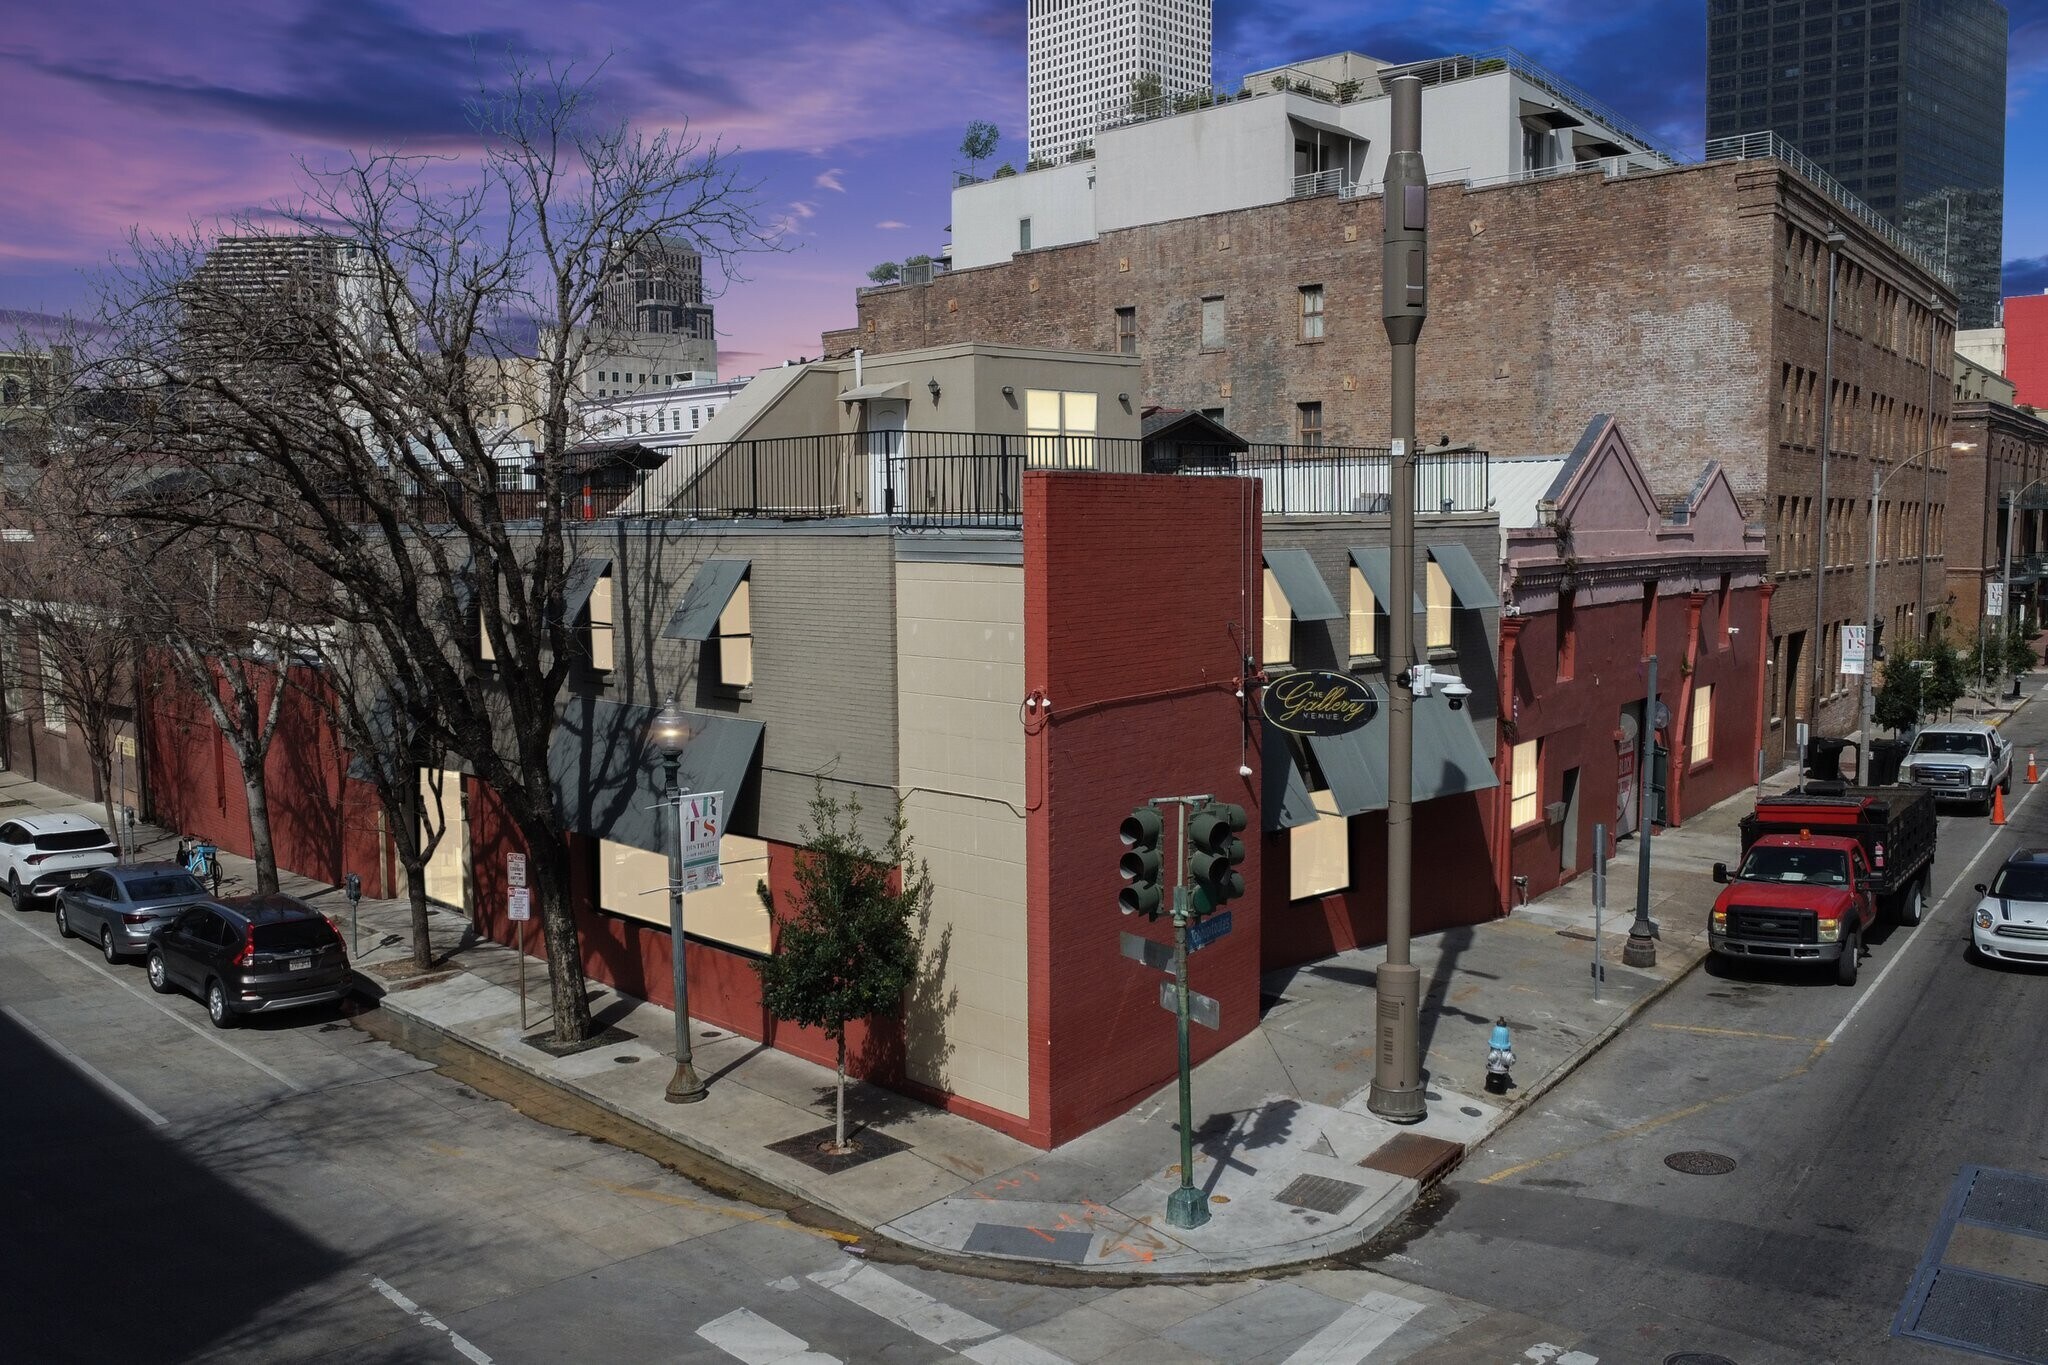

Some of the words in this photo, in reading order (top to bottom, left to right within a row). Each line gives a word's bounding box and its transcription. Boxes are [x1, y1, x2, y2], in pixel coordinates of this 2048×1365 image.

[1309, 691, 1324, 699] THE
[1276, 681, 1365, 722] Gallery
[1303, 712, 1340, 721] VENUE
